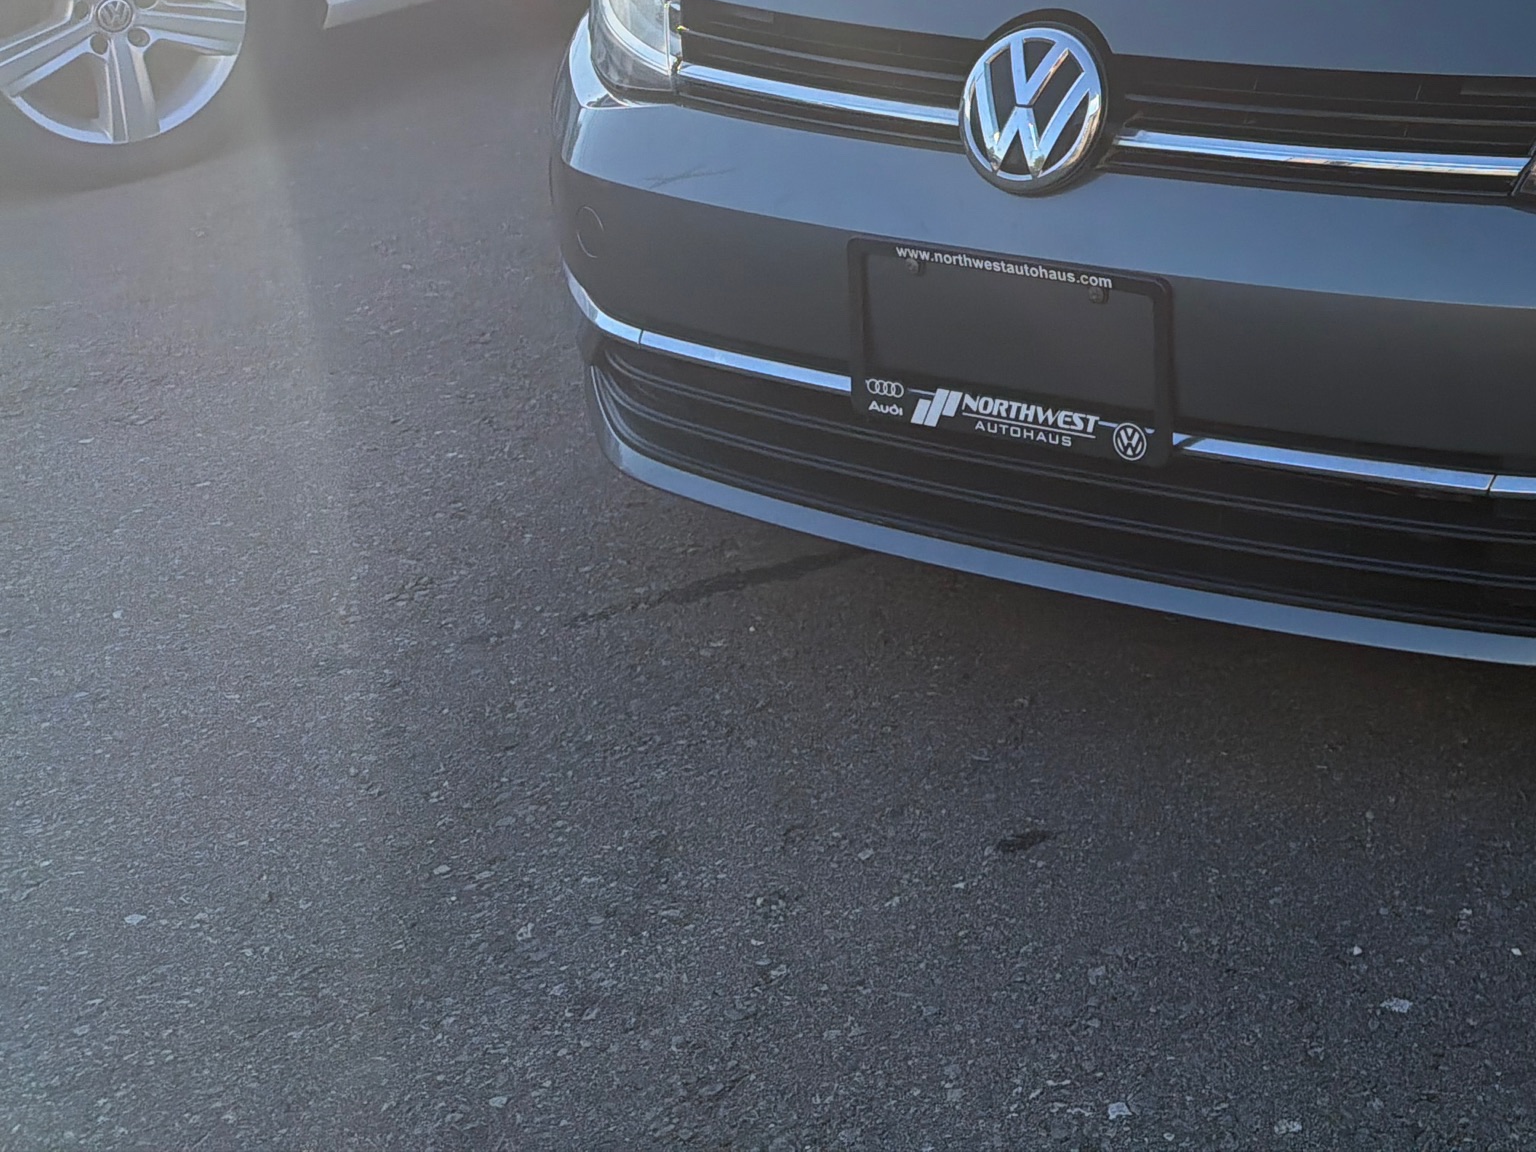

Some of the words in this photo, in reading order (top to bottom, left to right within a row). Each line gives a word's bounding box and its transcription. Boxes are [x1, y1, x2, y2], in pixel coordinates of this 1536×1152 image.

[896, 246, 1113, 289] www.northwestautohaus.com
[868, 400, 904, 416] Audi
[961, 393, 1100, 434] NORTHWEST
[974, 420, 1073, 447] AUTOHAUS
